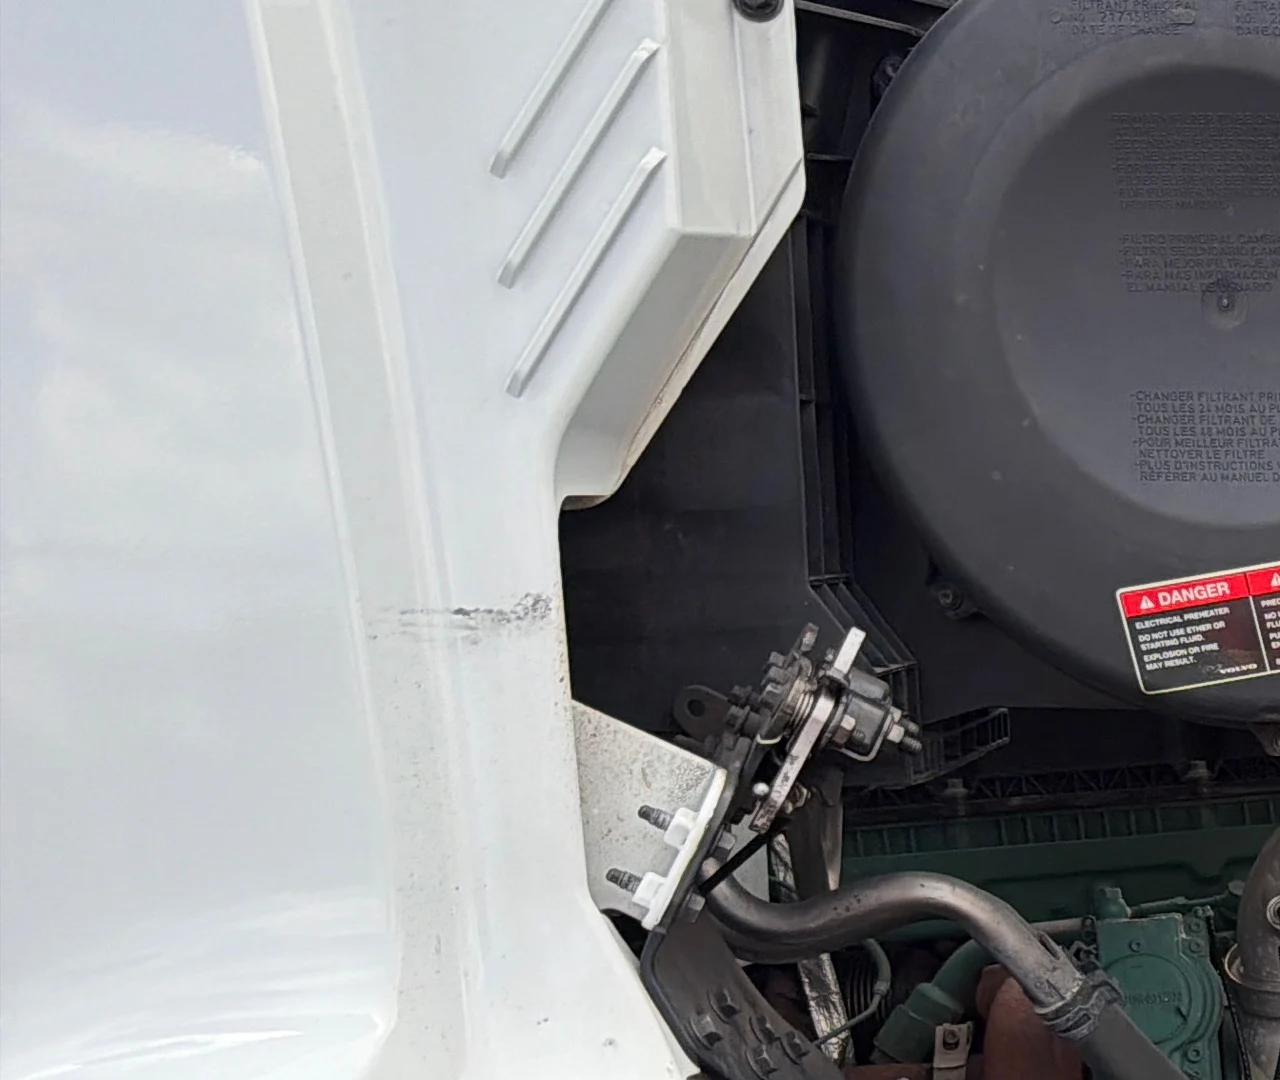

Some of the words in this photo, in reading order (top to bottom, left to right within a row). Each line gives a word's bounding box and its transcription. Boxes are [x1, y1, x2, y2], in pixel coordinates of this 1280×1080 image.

[1136, 402, 1168, 412] TOUS
[1172, 403, 1195, 413] LES
[1216, 403, 1245, 413] MOIS
[1250, 404, 1265, 413] AU
[1138, 426, 1169, 436] TOUS
[1173, 427, 1196, 436] LES
[1217, 427, 1247, 436] MOIS
[1175, 438, 1234, 448] MEILLEUR
[1139, 449, 1203, 459] NETTOYER
[1206, 450, 1221, 459] LE
[1224, 450, 1265, 459] FILTRE
[1201, 472, 1219, 481] AU
[1221, 472, 1267, 481] MANUEL
[1157, 581, 1231, 606] DANGER
[1135, 615, 1183, 630] ELECTRICAL
[1183, 606, 1231, 622] PREHEATER
[1264, 611, 1277, 620] NO
[1138, 633, 1151, 642] DO
[1151, 630, 1168, 640] NOT
[1169, 627, 1186, 637] USE
[1186, 623, 1213, 635] ETHER
[1212, 620, 1226, 631] OR
[1140, 638, 1180, 651] STARTING
[1179, 633, 1206, 645] FLUID.
[1143, 648, 1188, 663] EXPLOSION
[1188, 645, 1201, 654] OR
[1201, 642, 1220, 653] FIRE
[1145, 661, 1163, 671] MAY
[1164, 656, 1197, 668] RESULT.
[1219, 663, 1258, 674] VOLVO
